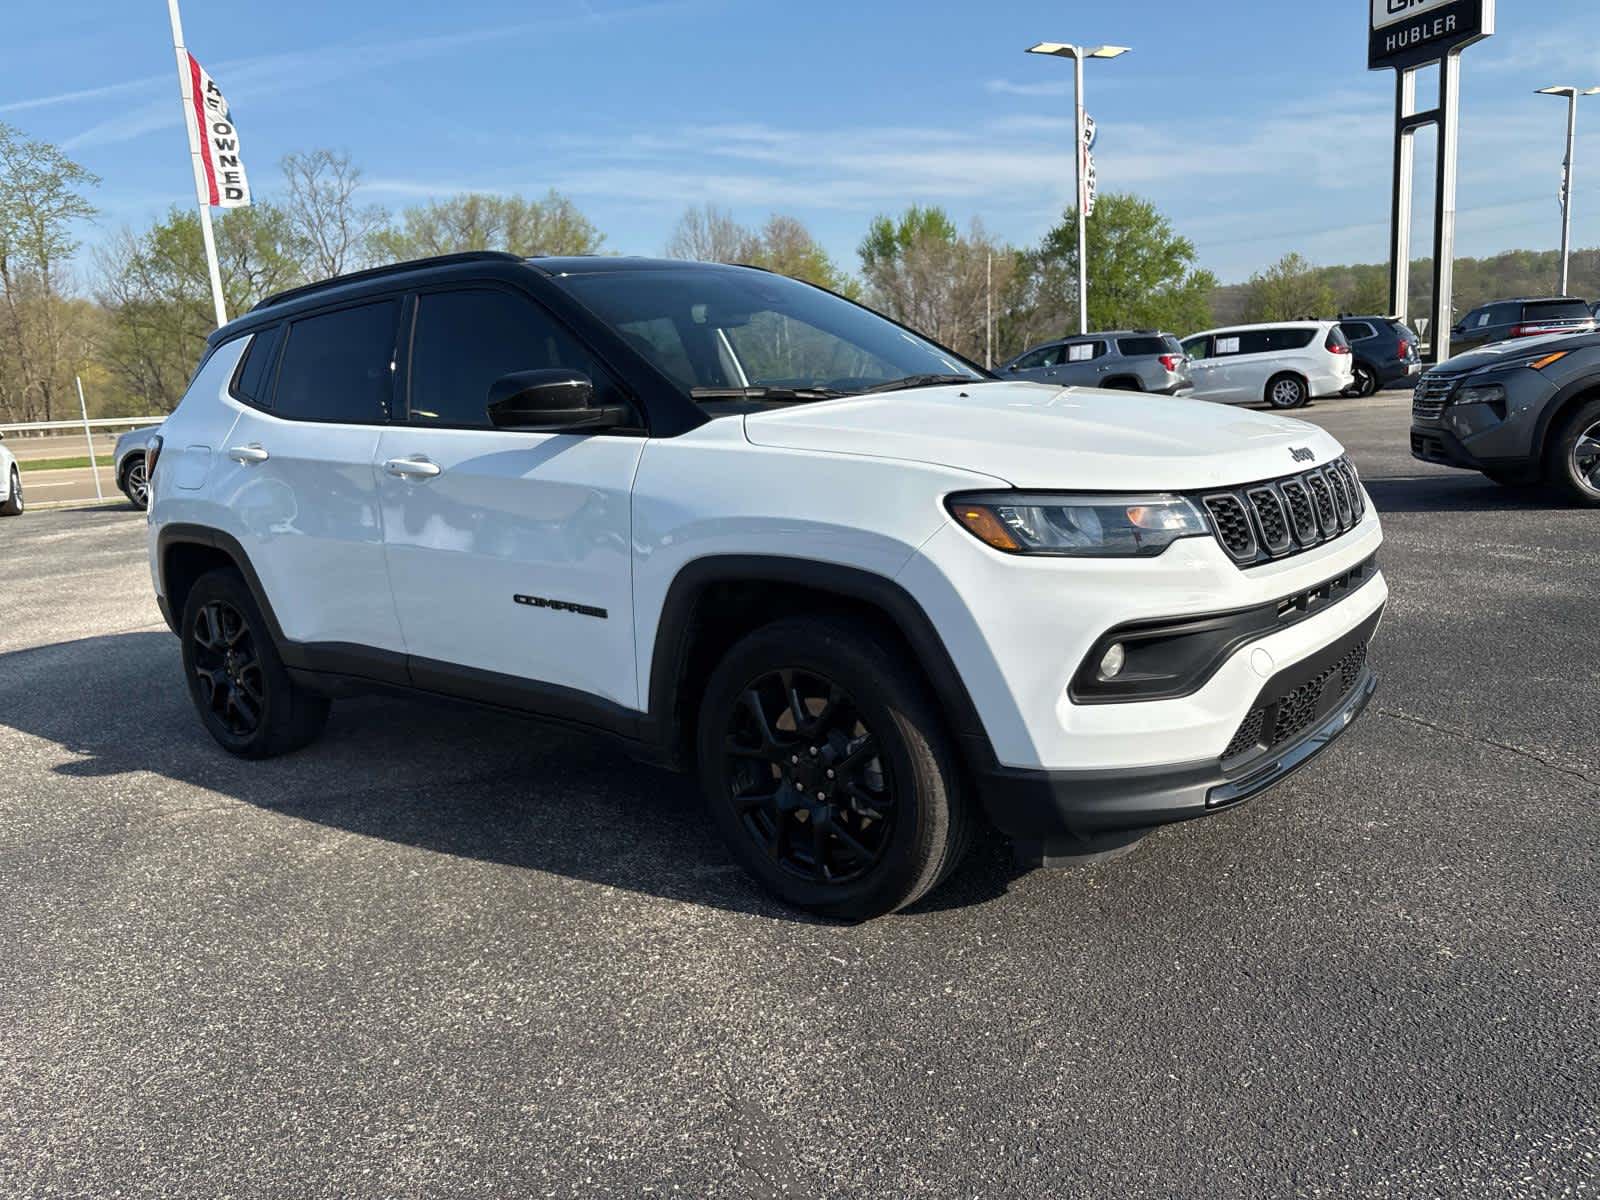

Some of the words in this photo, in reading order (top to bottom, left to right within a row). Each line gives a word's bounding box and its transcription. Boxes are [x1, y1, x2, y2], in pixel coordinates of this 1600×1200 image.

[1386, 14, 1456, 51] HUBLER
[213, 122, 243, 200] OWNED
[1287, 446, 1315, 462] Jeep
[513, 593, 608, 619] COMPASS
